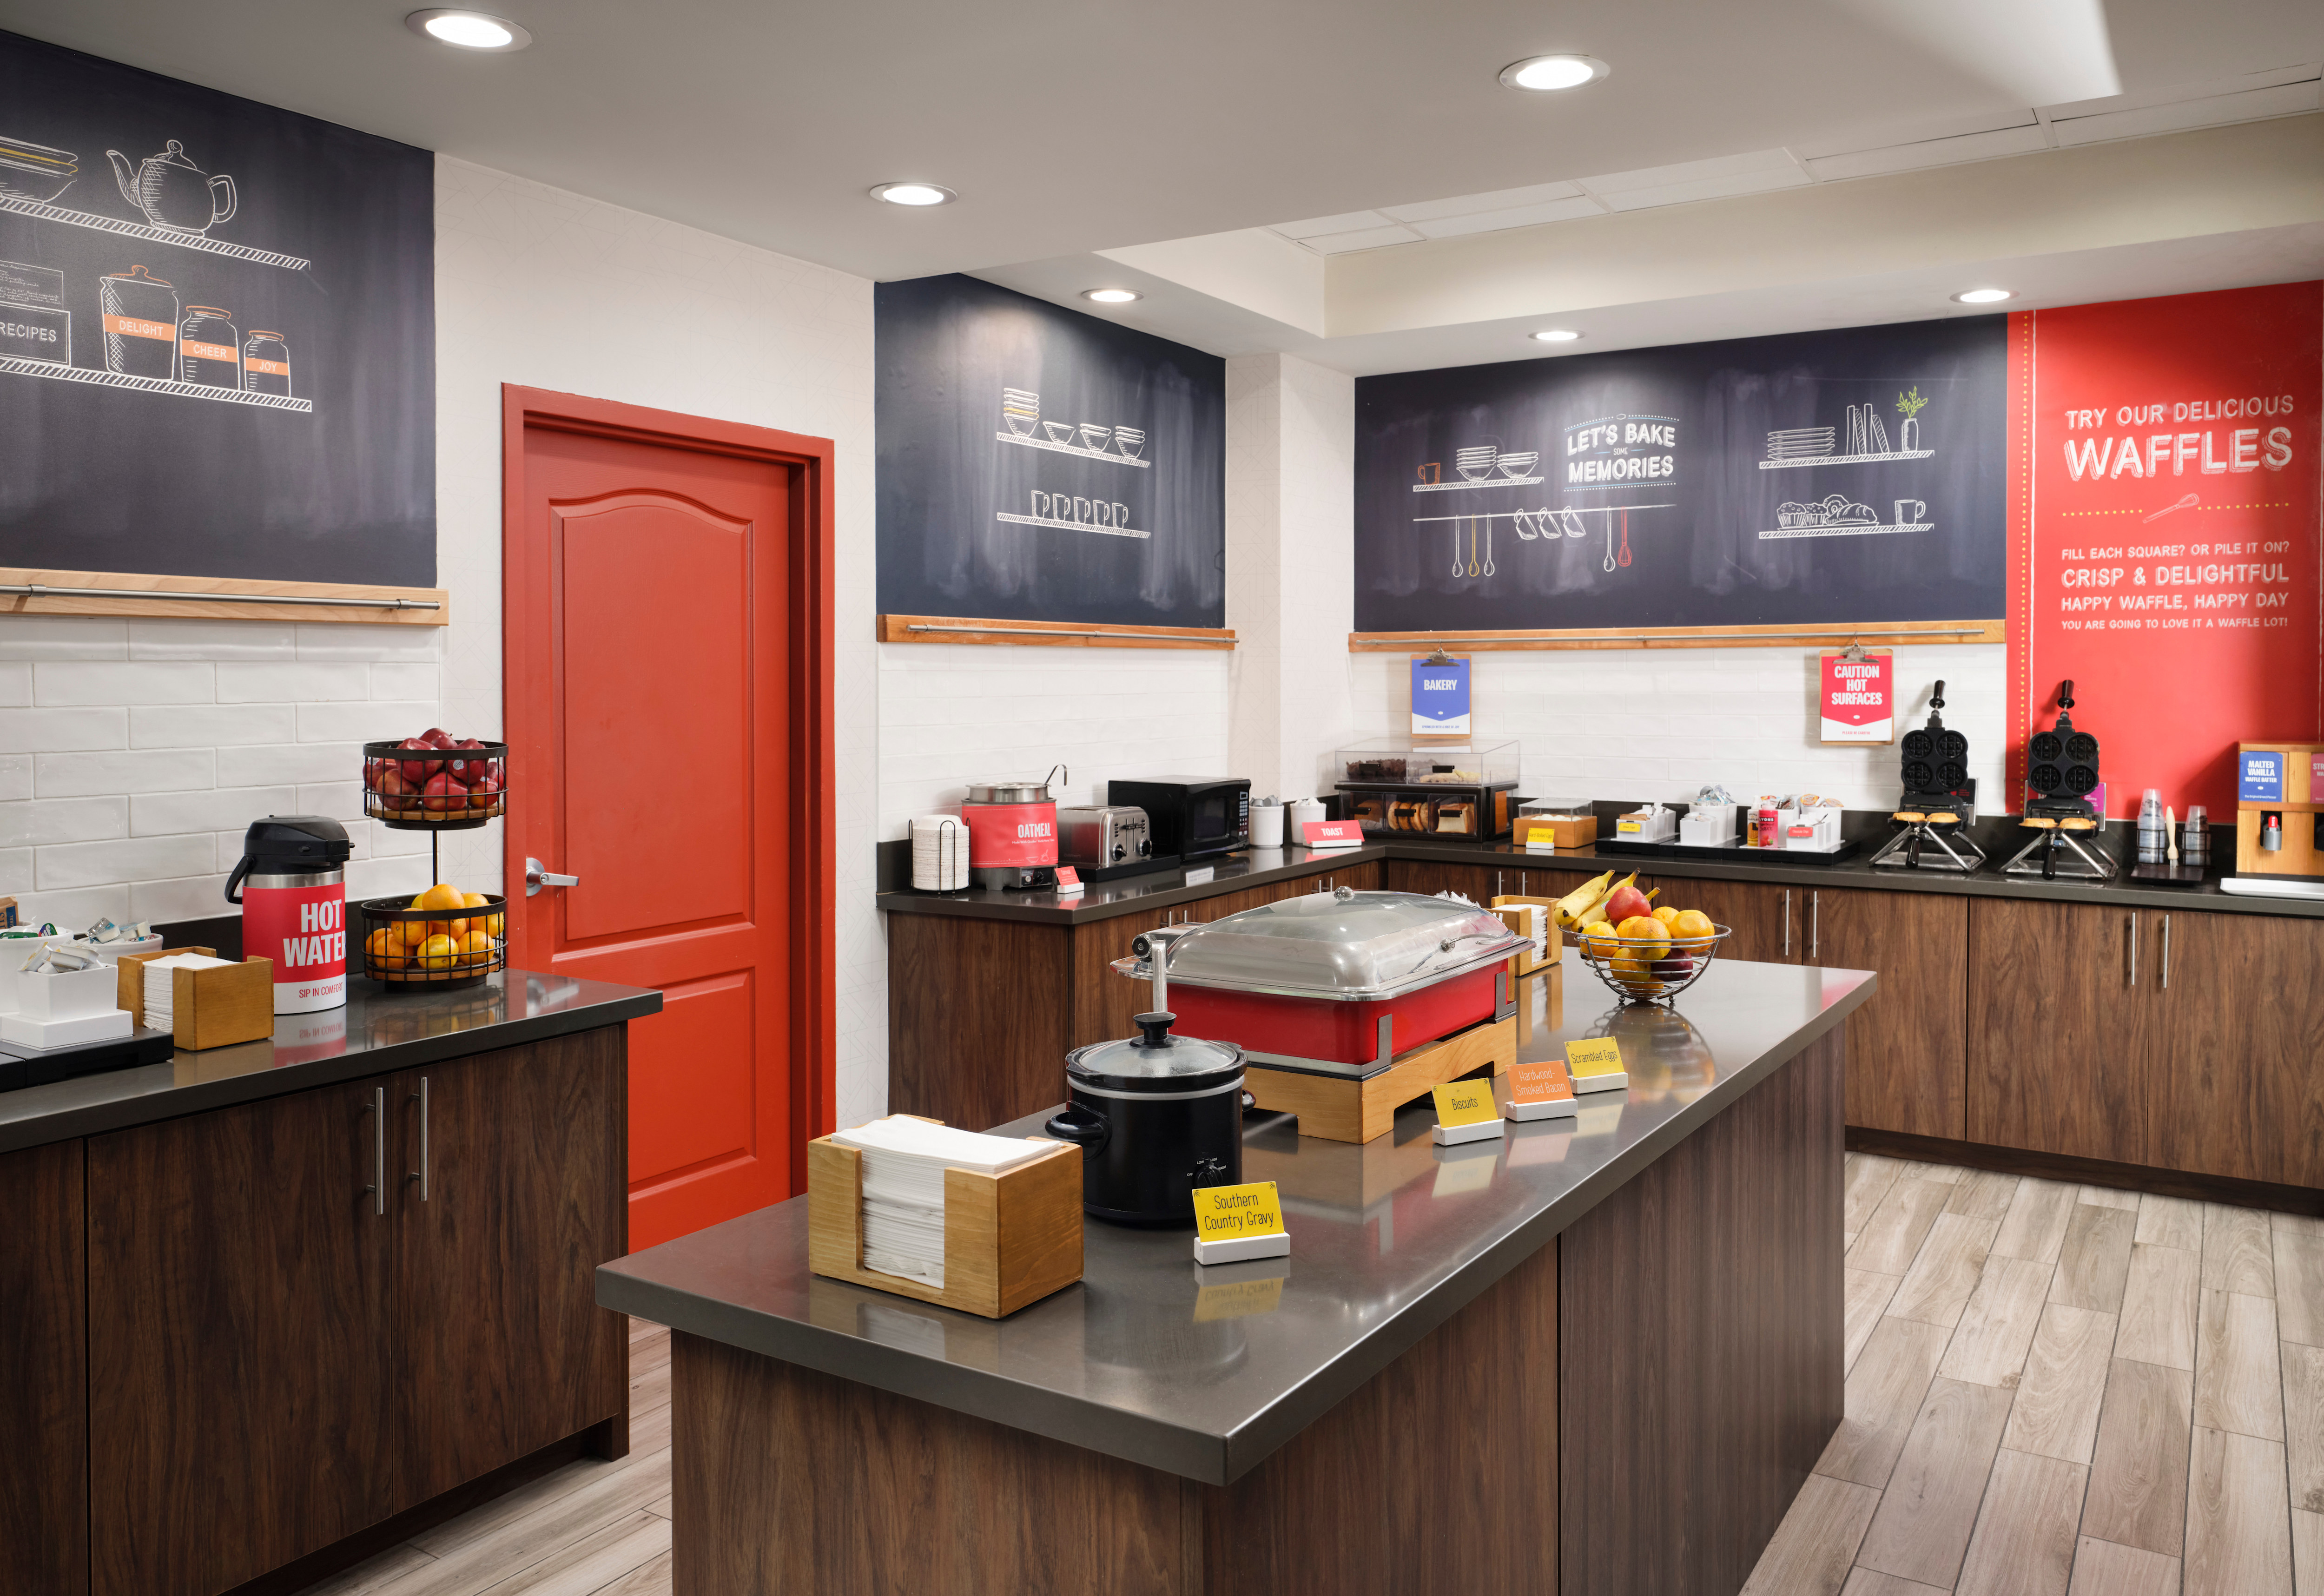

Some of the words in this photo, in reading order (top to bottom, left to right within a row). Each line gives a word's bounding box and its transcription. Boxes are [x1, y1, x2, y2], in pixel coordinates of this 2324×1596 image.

[0, 322, 56, 343] RECIPES
[119, 320, 163, 336] DELIGHT
[193, 344, 226, 359] CHEER
[259, 361, 277, 372] JOY
[2065, 408, 2107, 429] TRY
[2116, 404, 2164, 427] OUR
[2173, 395, 2293, 423] DELICIOUS
[1567, 424, 1618, 456] LET'S
[1625, 423, 1675, 448] BAKE
[1613, 447, 1629, 455] SOME
[2064, 427, 2293, 481] WAFFLES
[1568, 455, 1673, 483] MEMORIES
[2062, 548, 2085, 561] FILL
[2090, 547, 2122, 559] EACH
[2127, 545, 2185, 558] SQUARE?
[2191, 544, 2209, 556] OR
[2214, 543, 2241, 555] PILE
[2246, 542, 2258, 554] IT
[2264, 541, 2289, 554] ON?
[2061, 568, 2124, 588] CRISP
[2133, 567, 2146, 586] &
[2155, 563, 2289, 586] DELIGHTFUL
[2061, 596, 2112, 611] HAPPY
[2119, 594, 2187, 611] WAFFLE,
[2194, 593, 2249, 609] HAPPY
[2256, 592, 2289, 608] DAY
[2061, 620, 2081, 630] YOU
[2085, 620, 2105, 630] ARE
[2109, 620, 2141, 629] GOING
[2145, 619, 2159, 628] TO
[2163, 619, 2189, 629] LOVE
[2192, 619, 2202, 628] IT
[2205, 619, 2213, 628] A
[2218, 617, 2259, 628] WAFFLE
[2264, 617, 2287, 627] LOT!
[1834, 665, 1880, 678] CAUTION
[1424, 679, 1457, 691] BAKERY
[1846, 679, 1868, 692] HOT
[1831, 692, 1882, 705] SURFACES
[2247, 768, 2275, 777] VANILLA
[1018, 823, 1051, 838] OATMEAL
[1320, 827, 1343, 836] TOAST
[301, 899, 342, 933] HOT
[283, 930, 346, 967] WATER
[299, 989, 310, 998] SIP
[313, 988, 319, 997] IN
[321, 982, 343, 995] COMFORT
[1571, 1052, 1602, 1064] Scrambled
[1603, 1049, 1618, 1062] Eggs
[1519, 1069, 1556, 1082] Hardwood-
[1516, 1086, 1545, 1097] Smoked
[1545, 1082, 1566, 1095] Bacon
[1451, 1097, 1478, 1110] Biscuits
[1214, 1193, 1259, 1210] Southern
[1204, 1214, 1243, 1231] Country
[1247, 1211, 1274, 1227] Gravy
